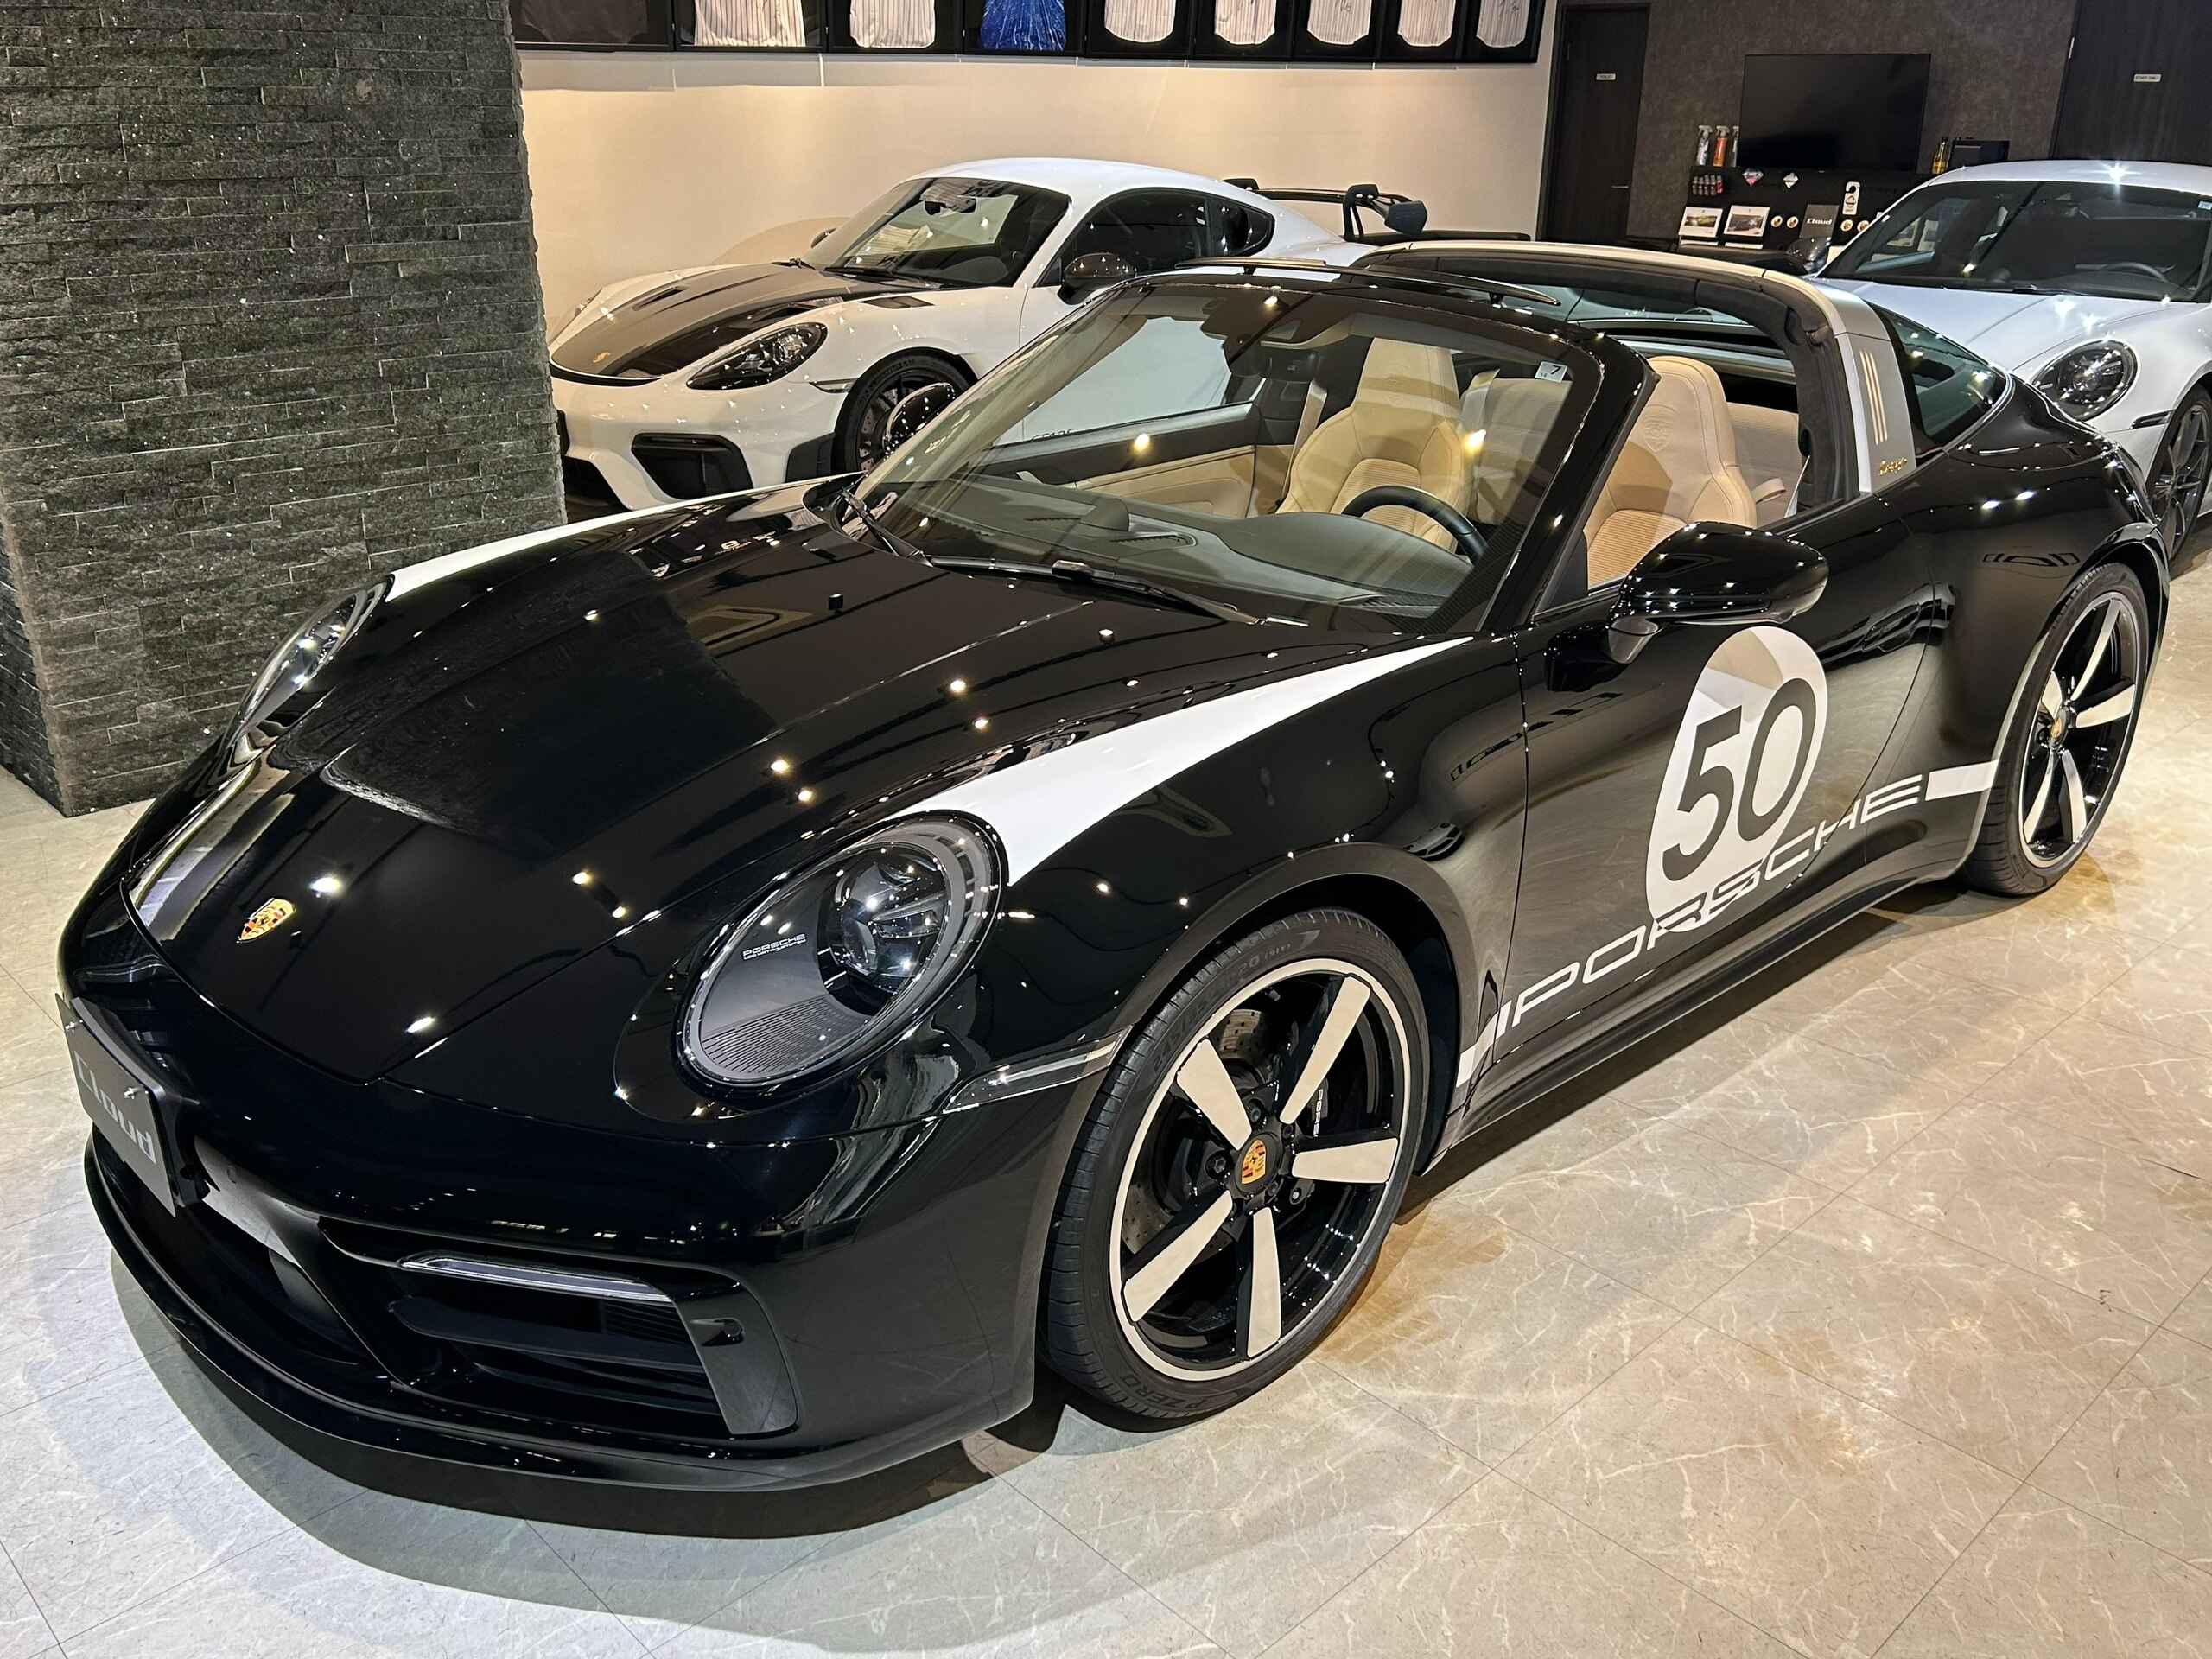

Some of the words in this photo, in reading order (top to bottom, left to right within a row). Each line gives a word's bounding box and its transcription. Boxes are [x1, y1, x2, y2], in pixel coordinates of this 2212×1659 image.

[1550, 365, 1562, 375] 7
[1662, 677, 1816, 881] 50
[1512, 774, 1923, 1027] PORSCHE
[743, 933, 805, 957] PORSCHE
[74, 1050, 156, 1164] Cloud
[1313, 1089, 1323, 1137] PORS
